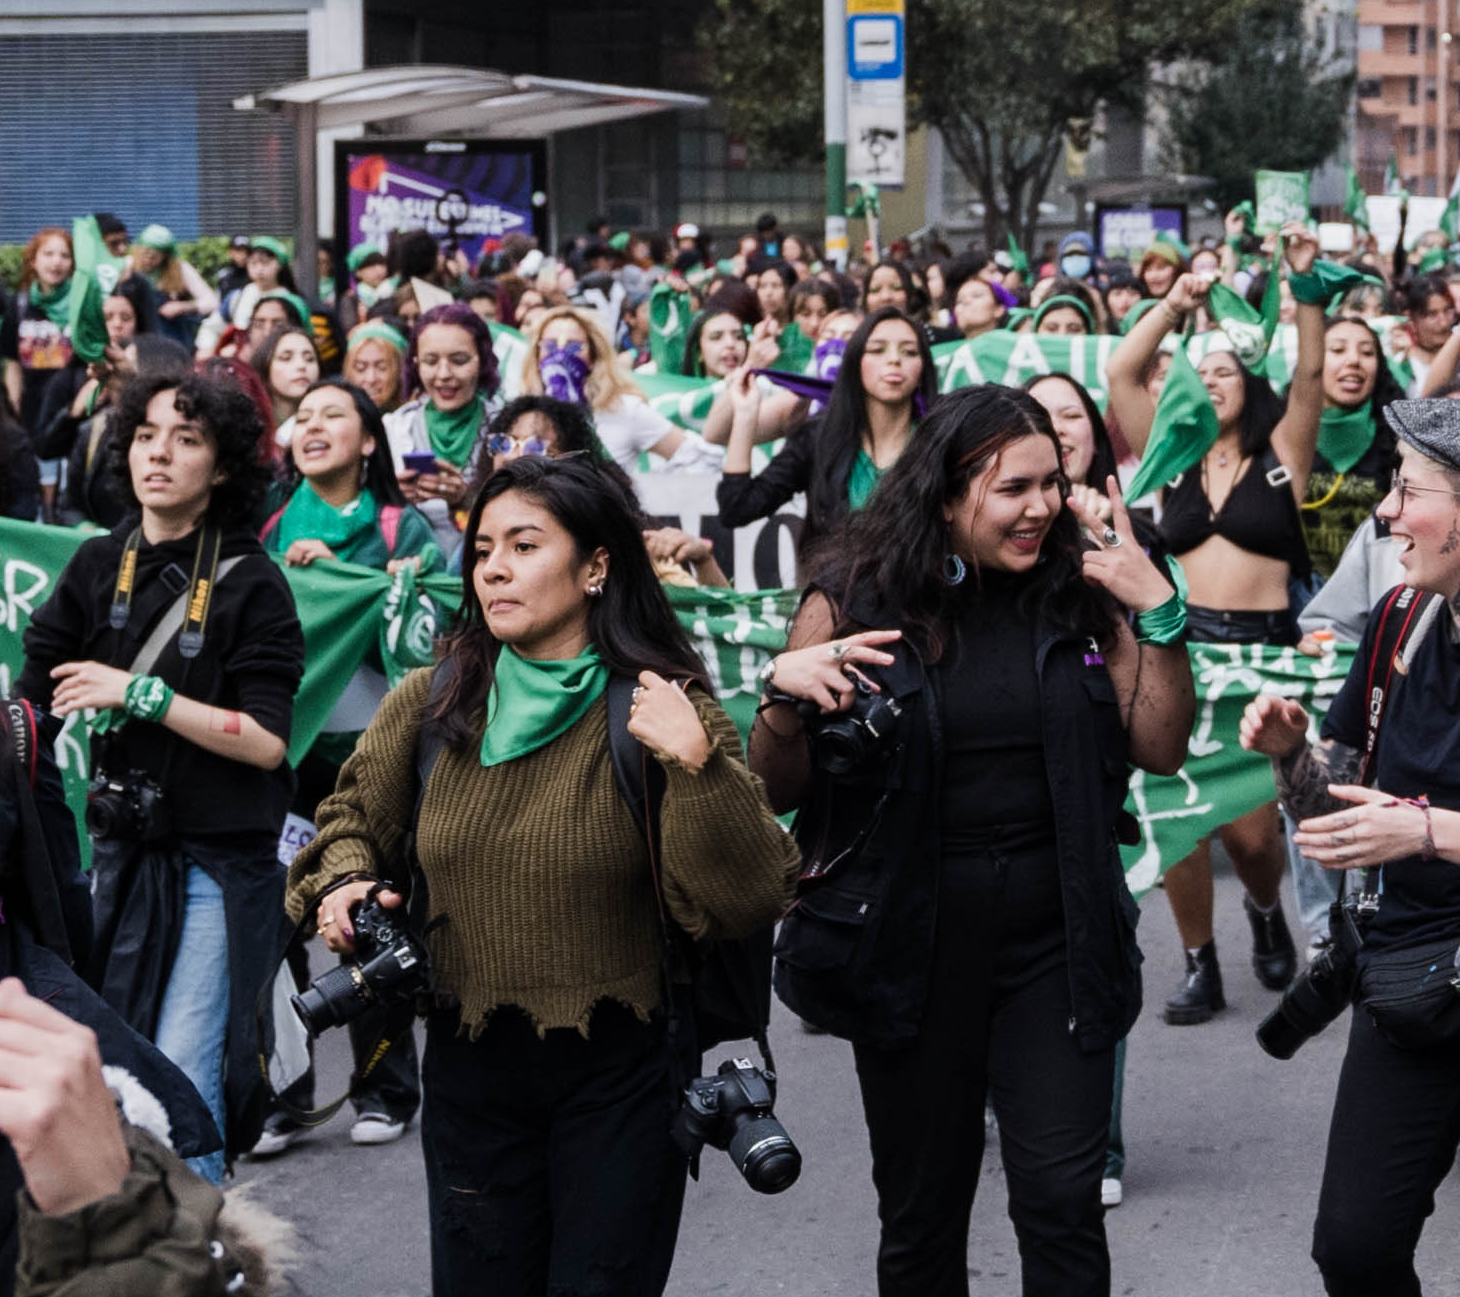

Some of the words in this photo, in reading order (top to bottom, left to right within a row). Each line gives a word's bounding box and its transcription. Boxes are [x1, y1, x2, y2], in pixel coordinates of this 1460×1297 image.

[117, 549, 136, 593] Nikon
[188, 578, 210, 622] Nikon
[1368, 686, 1385, 729] EOS
